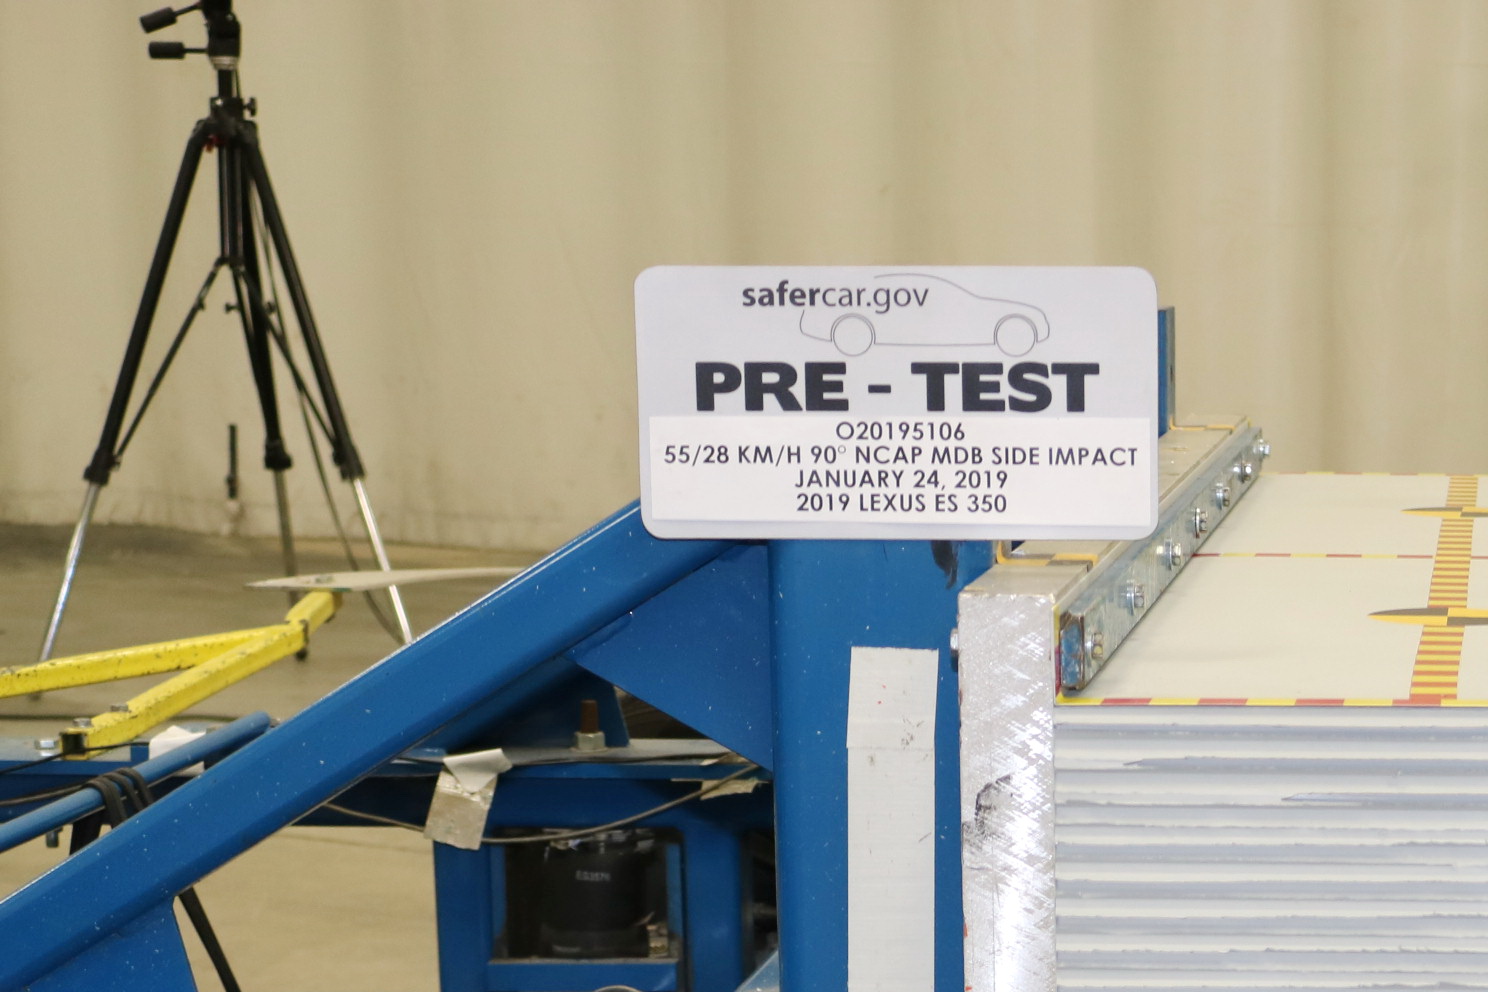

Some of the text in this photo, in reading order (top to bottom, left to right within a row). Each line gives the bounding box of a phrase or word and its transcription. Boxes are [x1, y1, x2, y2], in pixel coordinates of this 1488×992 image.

[742, 280, 929, 314] safercar.gov
[695, 361, 850, 412] PRE
[910, 361, 1100, 413] TEST
[665, 445, 729, 466] 55/28
[738, 446, 801, 466] KM/H
[855, 445, 923, 464] NCAP
[931, 446, 983, 465] MDB
[992, 446, 1039, 465] SIDE
[1048, 447, 1137, 466] IMPACT
[795, 470, 1008, 491] JANUARY 24, 2019
[797, 493, 1007, 513] 2019 LEXUS ES 350
